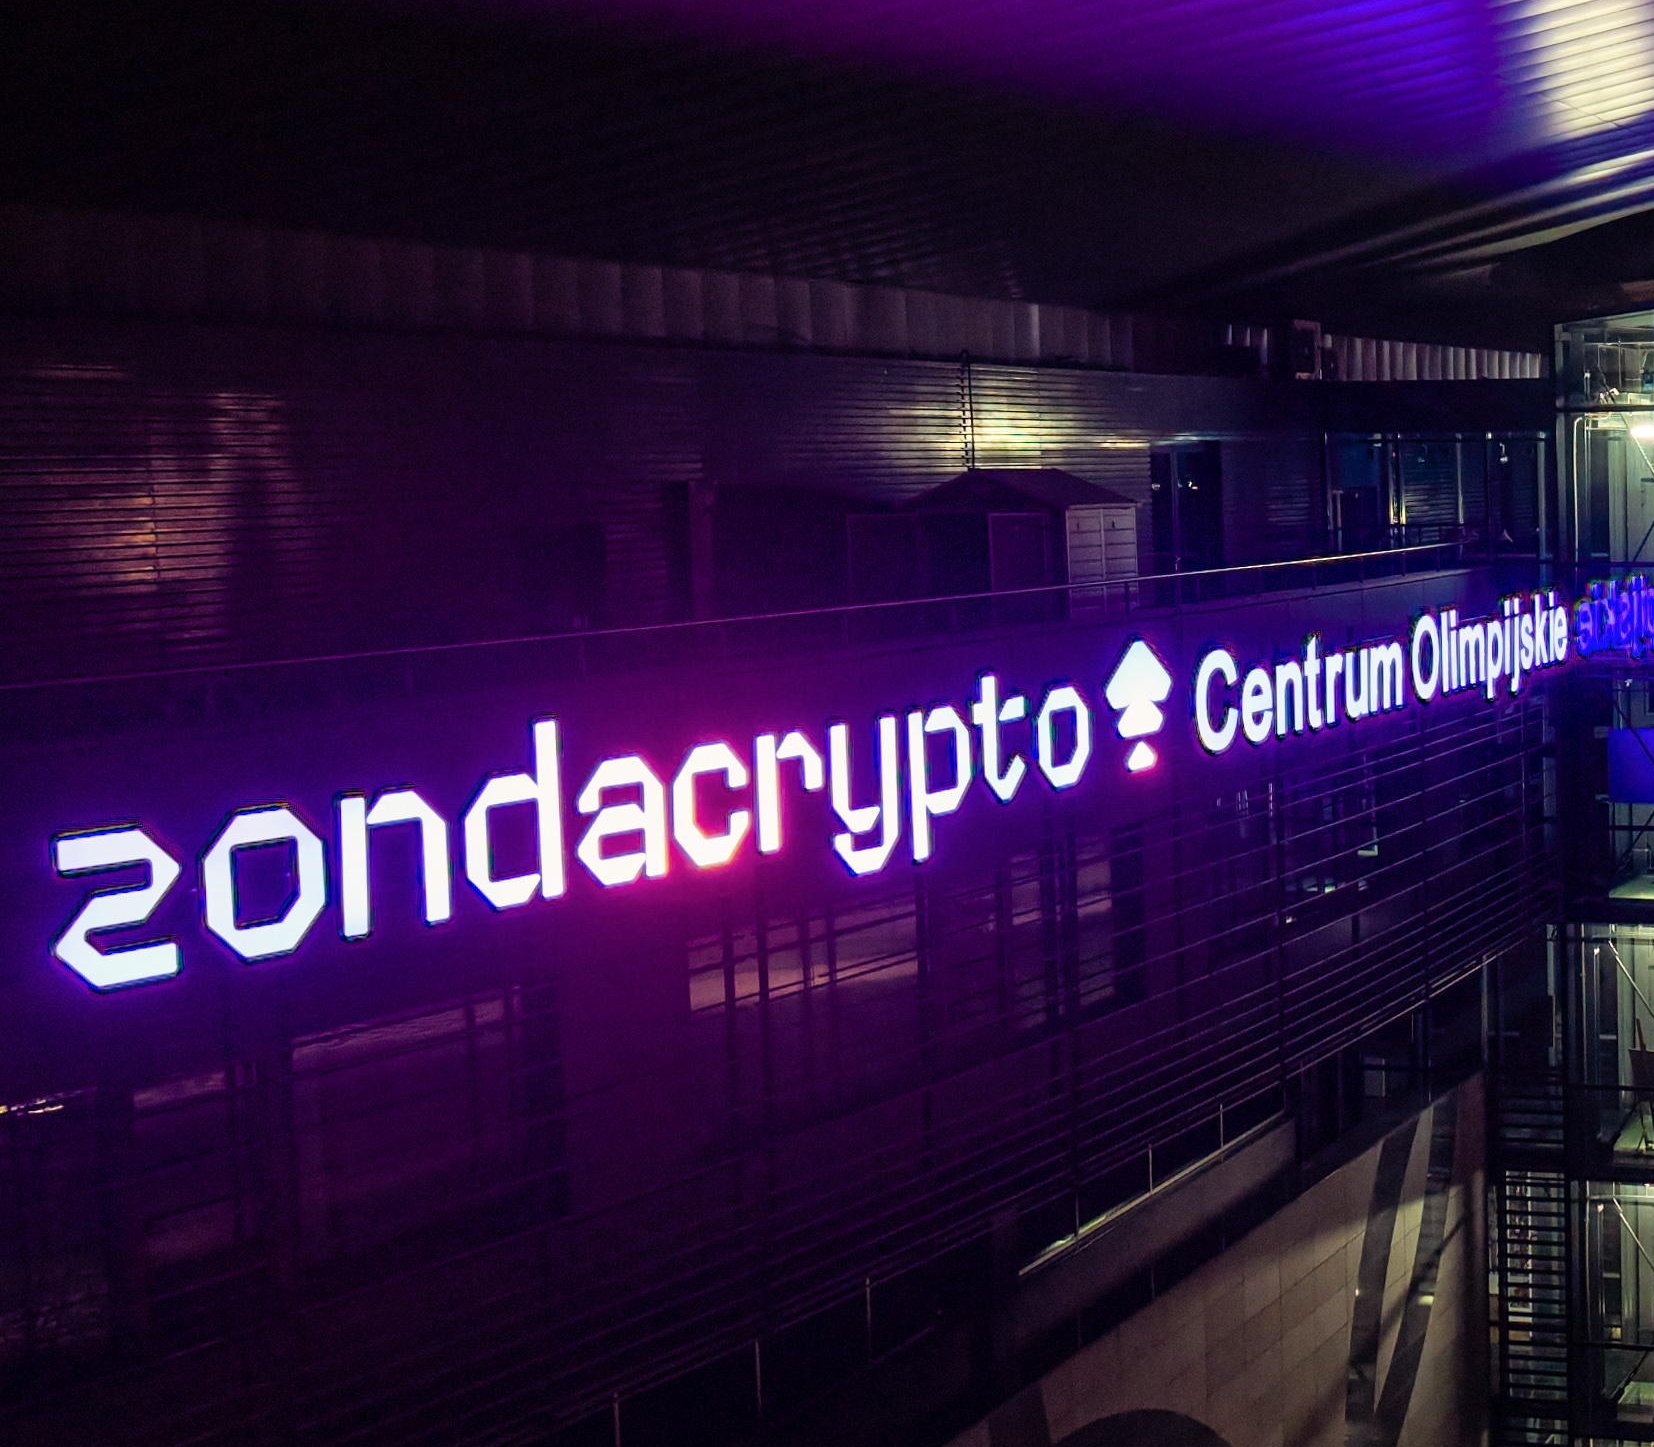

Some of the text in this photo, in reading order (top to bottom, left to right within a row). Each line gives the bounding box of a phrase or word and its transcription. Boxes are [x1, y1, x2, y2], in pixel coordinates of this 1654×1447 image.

[1194, 632, 1404, 754] Centrum
[1411, 590, 1568, 700] Olimpijskie
[54, 674, 1091, 989] zondacrypto
